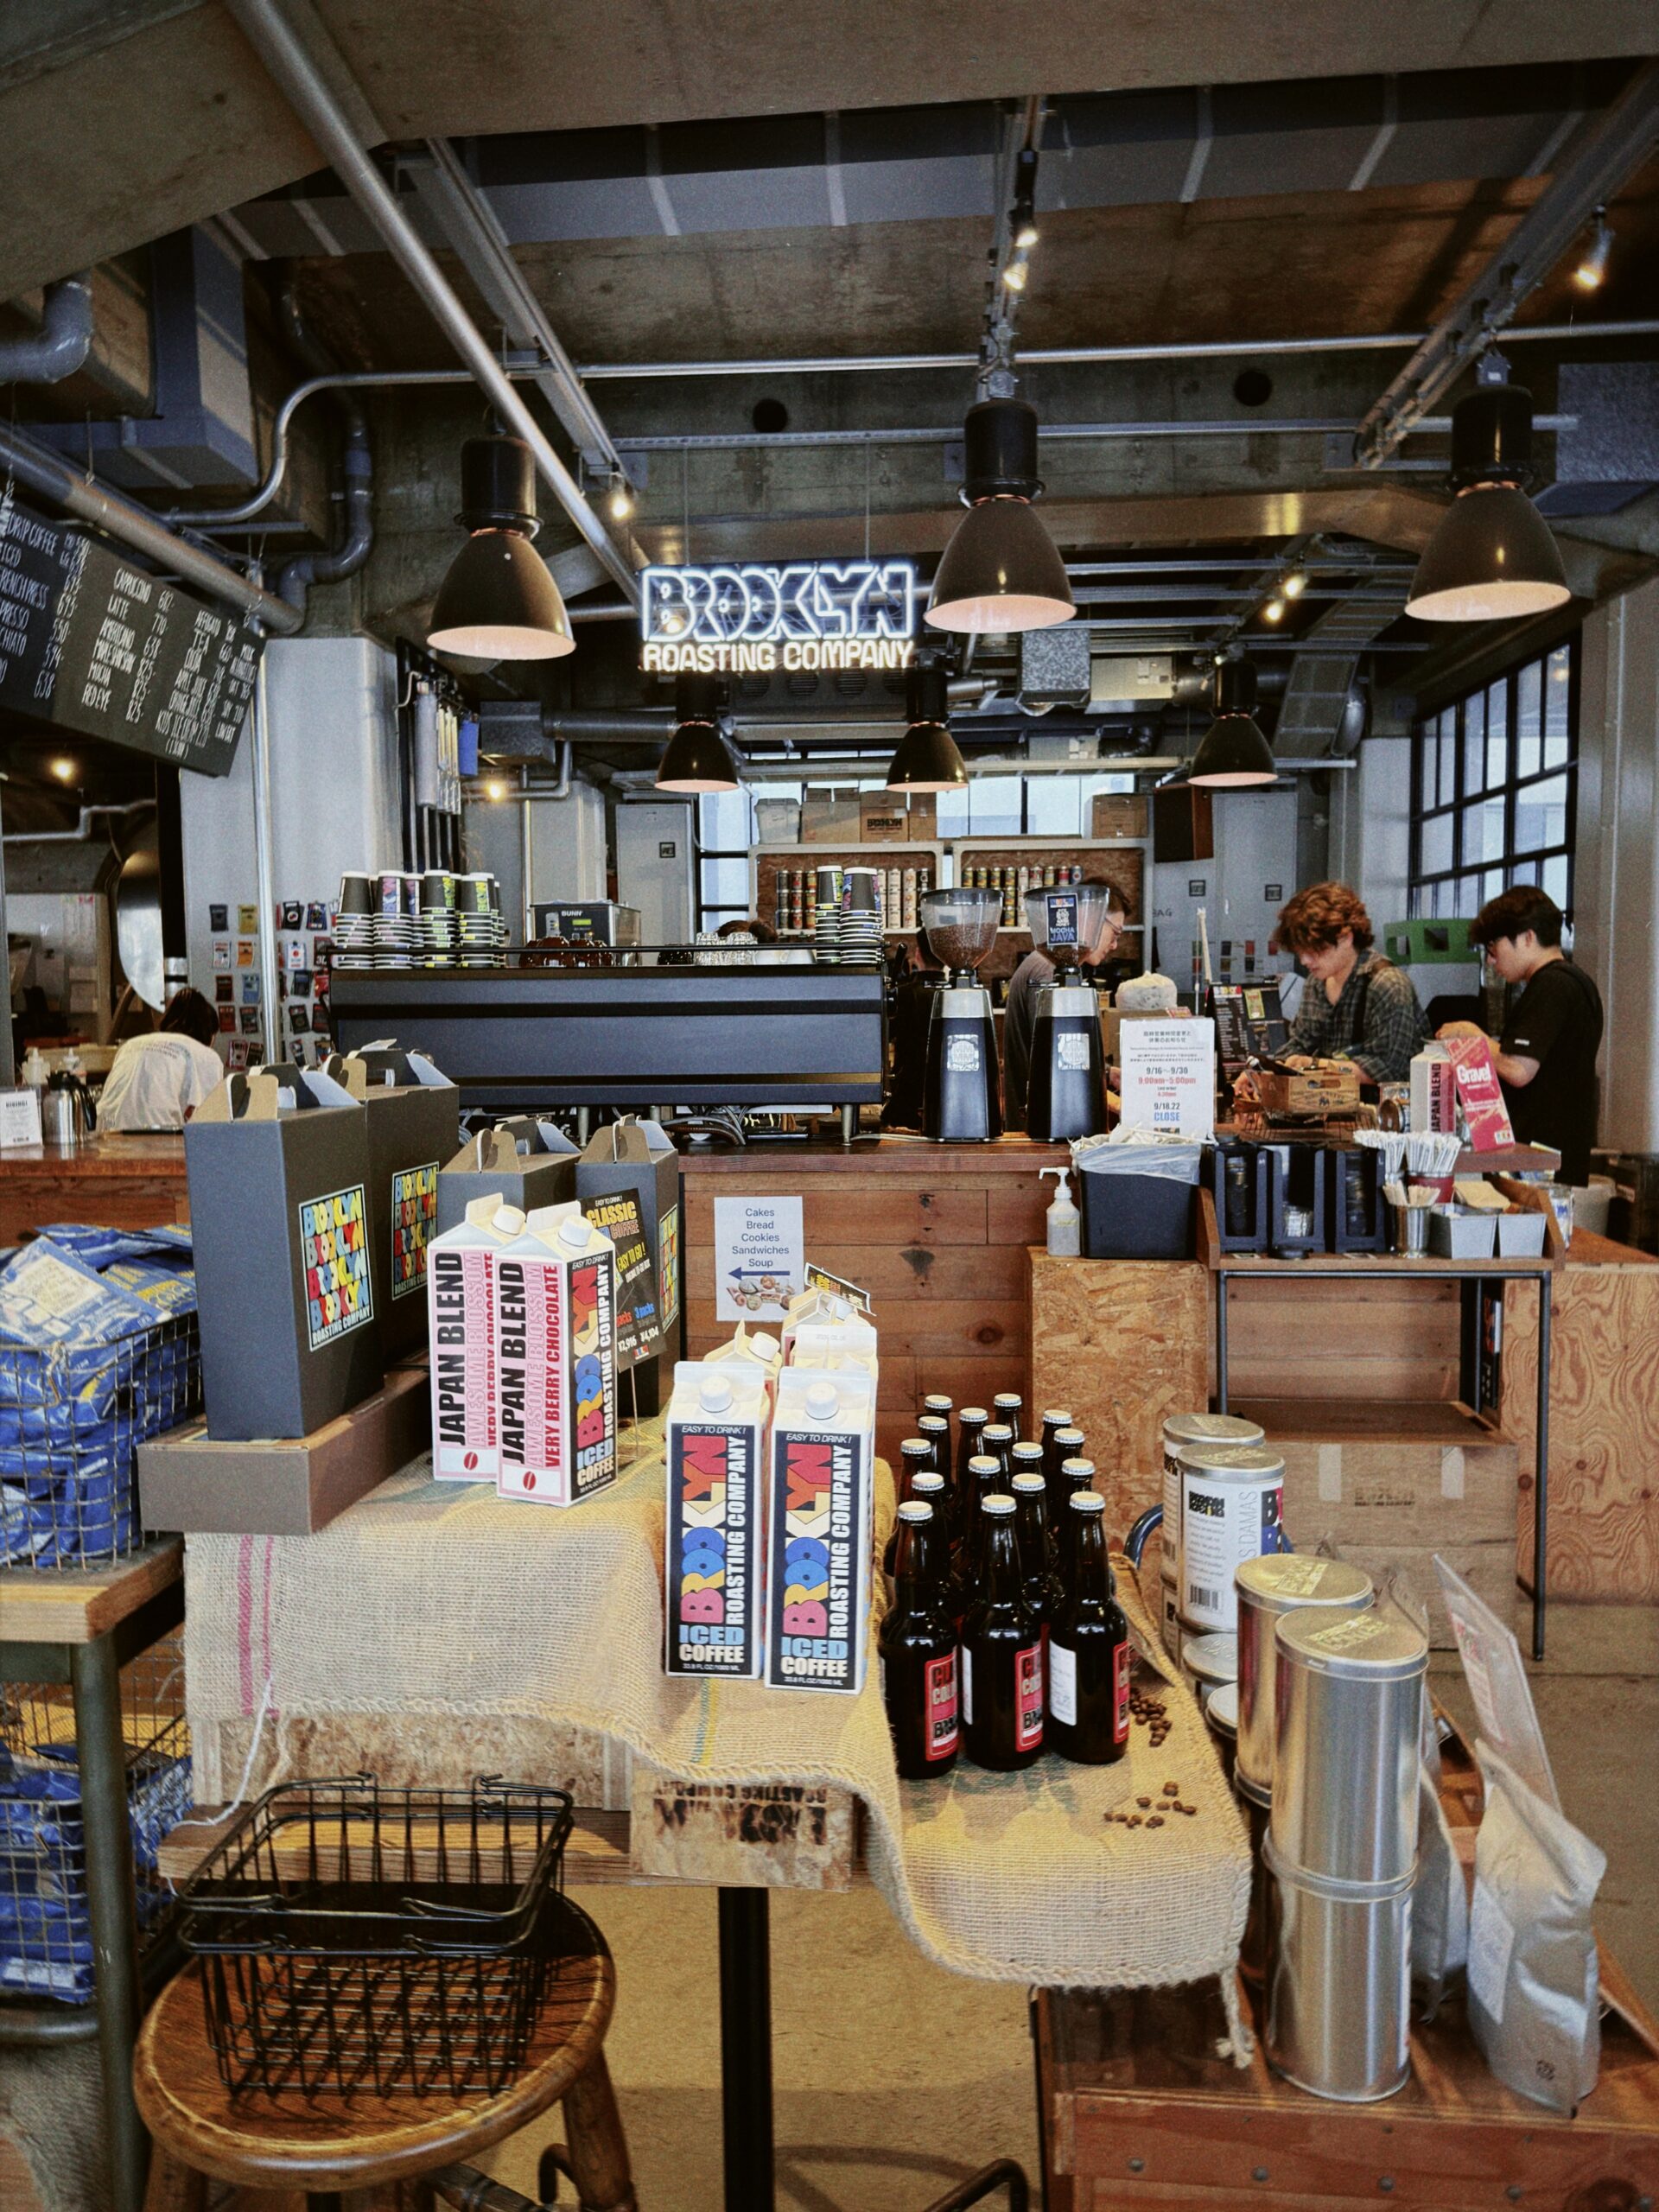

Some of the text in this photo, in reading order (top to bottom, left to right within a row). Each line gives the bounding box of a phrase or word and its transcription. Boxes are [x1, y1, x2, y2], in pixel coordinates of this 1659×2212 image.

[7, 512, 59, 557] DRIP COFFEE
[107, 594, 130, 621] LATTE
[643, 566, 914, 641] BROOKLYN
[643, 640, 915, 672] ROASTING COMPANY
[1050, 933, 1075, 942] JAVA
[1431, 1063, 1441, 1097] BLEND
[1456, 1061, 1492, 1084] Gravel
[1154, 1111, 1180, 1122] CLOSE
[303, 1190, 363, 1238] BROOKLYN
[586, 1201, 637, 1229] CLASSIC
[745, 1208, 775, 1217] Cakes
[747, 1221, 774, 1230] Bread
[305, 1219, 365, 1268] BROOKLYN
[610, 1219, 639, 1239] COFFEE
[741, 1233, 780, 1243] Cookies
[572, 1261, 585, 1270] EASY
[585, 1258, 594, 1268] TO
[617, 1255, 630, 1273] EASY
[627, 1249, 636, 1265] TO
[732, 1246, 790, 1255] Sandwiches
[748, 1258, 773, 1268] Soup
[308, 1248, 367, 1300] BROOKLYN
[309, 1276, 370, 1332] BROOKLYN
[312, 1306, 371, 1346] ROASTING COMPANY
[435, 1252, 466, 1446] JAPAN BLEND
[464, 1251, 486, 1447] AWESOME BLOSSOM
[499, 1262, 526, 1465] JAPAN BLEND
[524, 1263, 545, 1467] AWESOME BLOSSOM
[571, 1266, 605, 1450] BROOKLYN
[596, 1263, 614, 1440] ROASTING COMPANY
[543, 1264, 561, 1468] VERY BERRY CHOCOLATE
[682, 1425, 703, 1433] EASY
[786, 1433, 807, 1441] EASY
[577, 1437, 614, 1470] ICED
[577, 1454, 614, 1486] COFFEE
[680, 1435, 727, 1624] BROOKLYN
[725, 1436, 747, 1624] ROASTING COMPANY
[1238, 1491, 1258, 1545] DAMAS
[783, 1443, 832, 1637] BROOKLYN
[830, 1445, 852, 1638] ROASTING COMPANY
[679, 1624, 745, 1646] ICED
[781, 1637, 848, 1659] ICED
[679, 1643, 745, 1663] COFFEE
[780, 1656, 848, 1677] COFFEE
